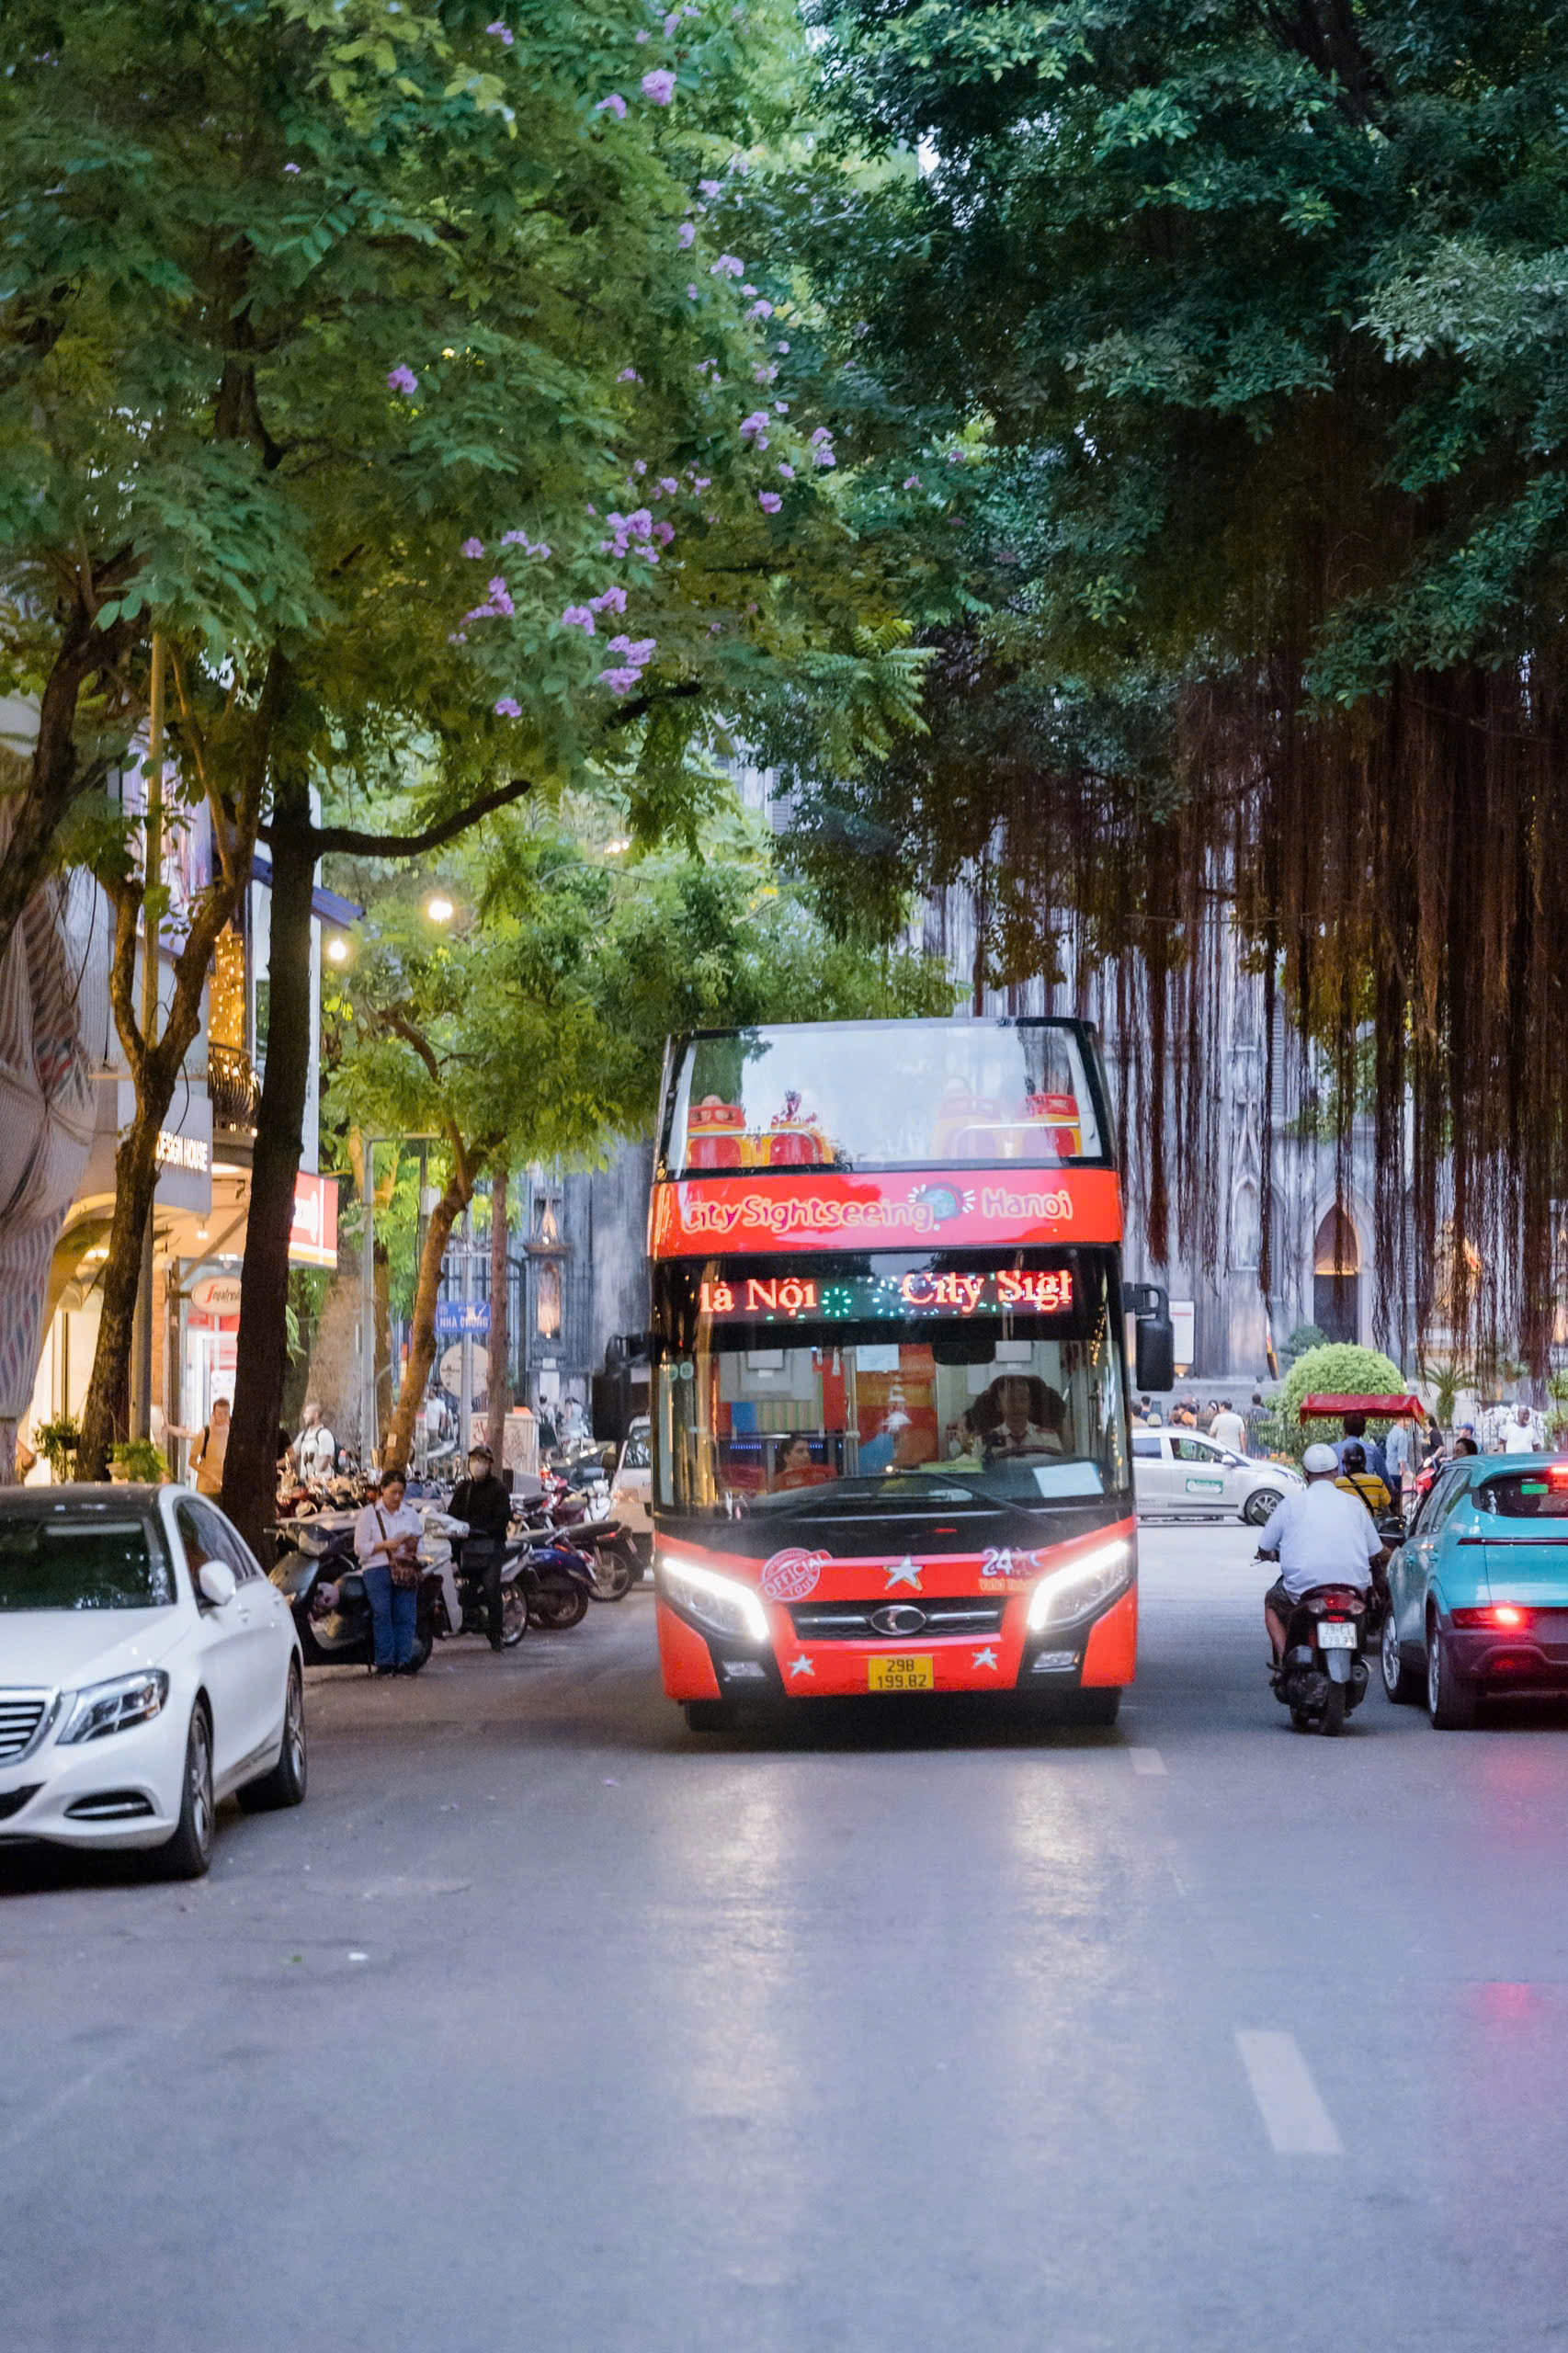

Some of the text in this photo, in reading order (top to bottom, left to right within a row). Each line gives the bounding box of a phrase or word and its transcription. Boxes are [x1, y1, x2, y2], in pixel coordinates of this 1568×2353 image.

[184, 1137, 208, 1172] HOUSE
[981, 1188, 1074, 1221] Hanoi
[902, 1276, 984, 1318] City
[887, 1659, 915, 1672] 29B
